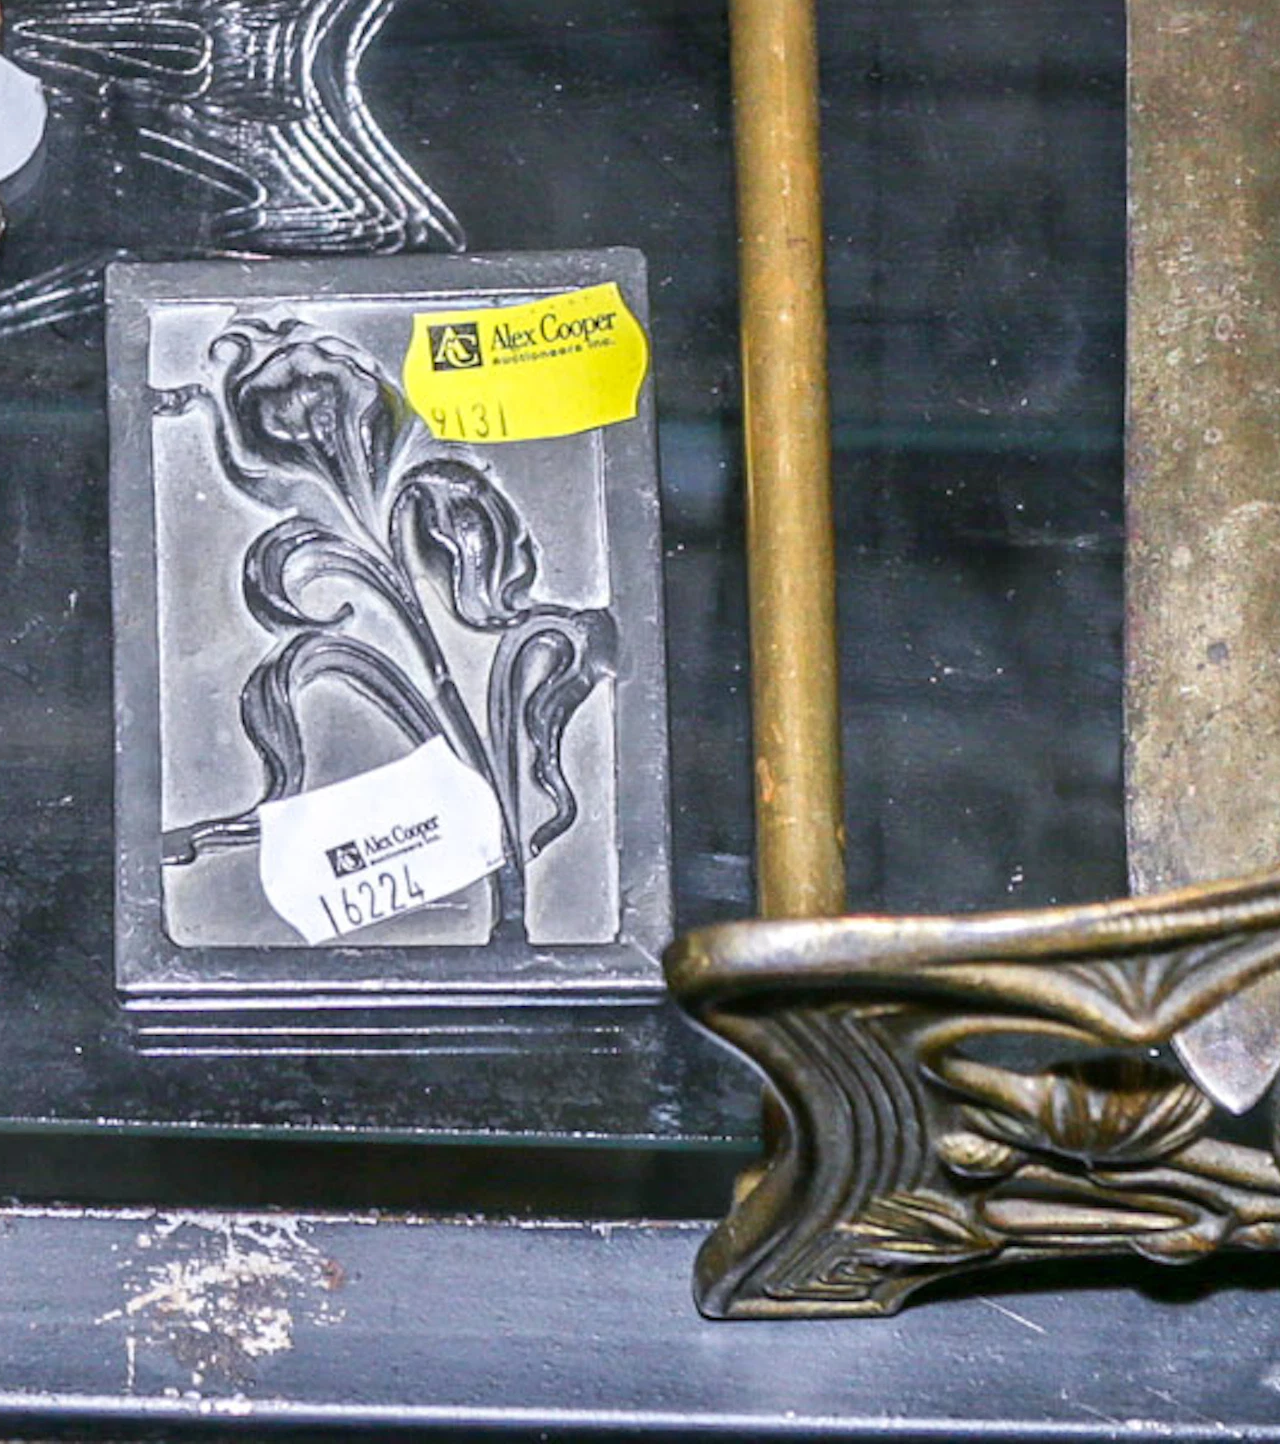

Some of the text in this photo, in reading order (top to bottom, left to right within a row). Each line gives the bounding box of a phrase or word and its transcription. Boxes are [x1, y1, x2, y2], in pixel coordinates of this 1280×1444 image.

[490, 312, 617, 351] Alex Cooper
[431, 400, 508, 438] 9131
[363, 836, 394, 857] Alex
[391, 814, 439, 844] Cooper
[319, 864, 425, 938] 16224
